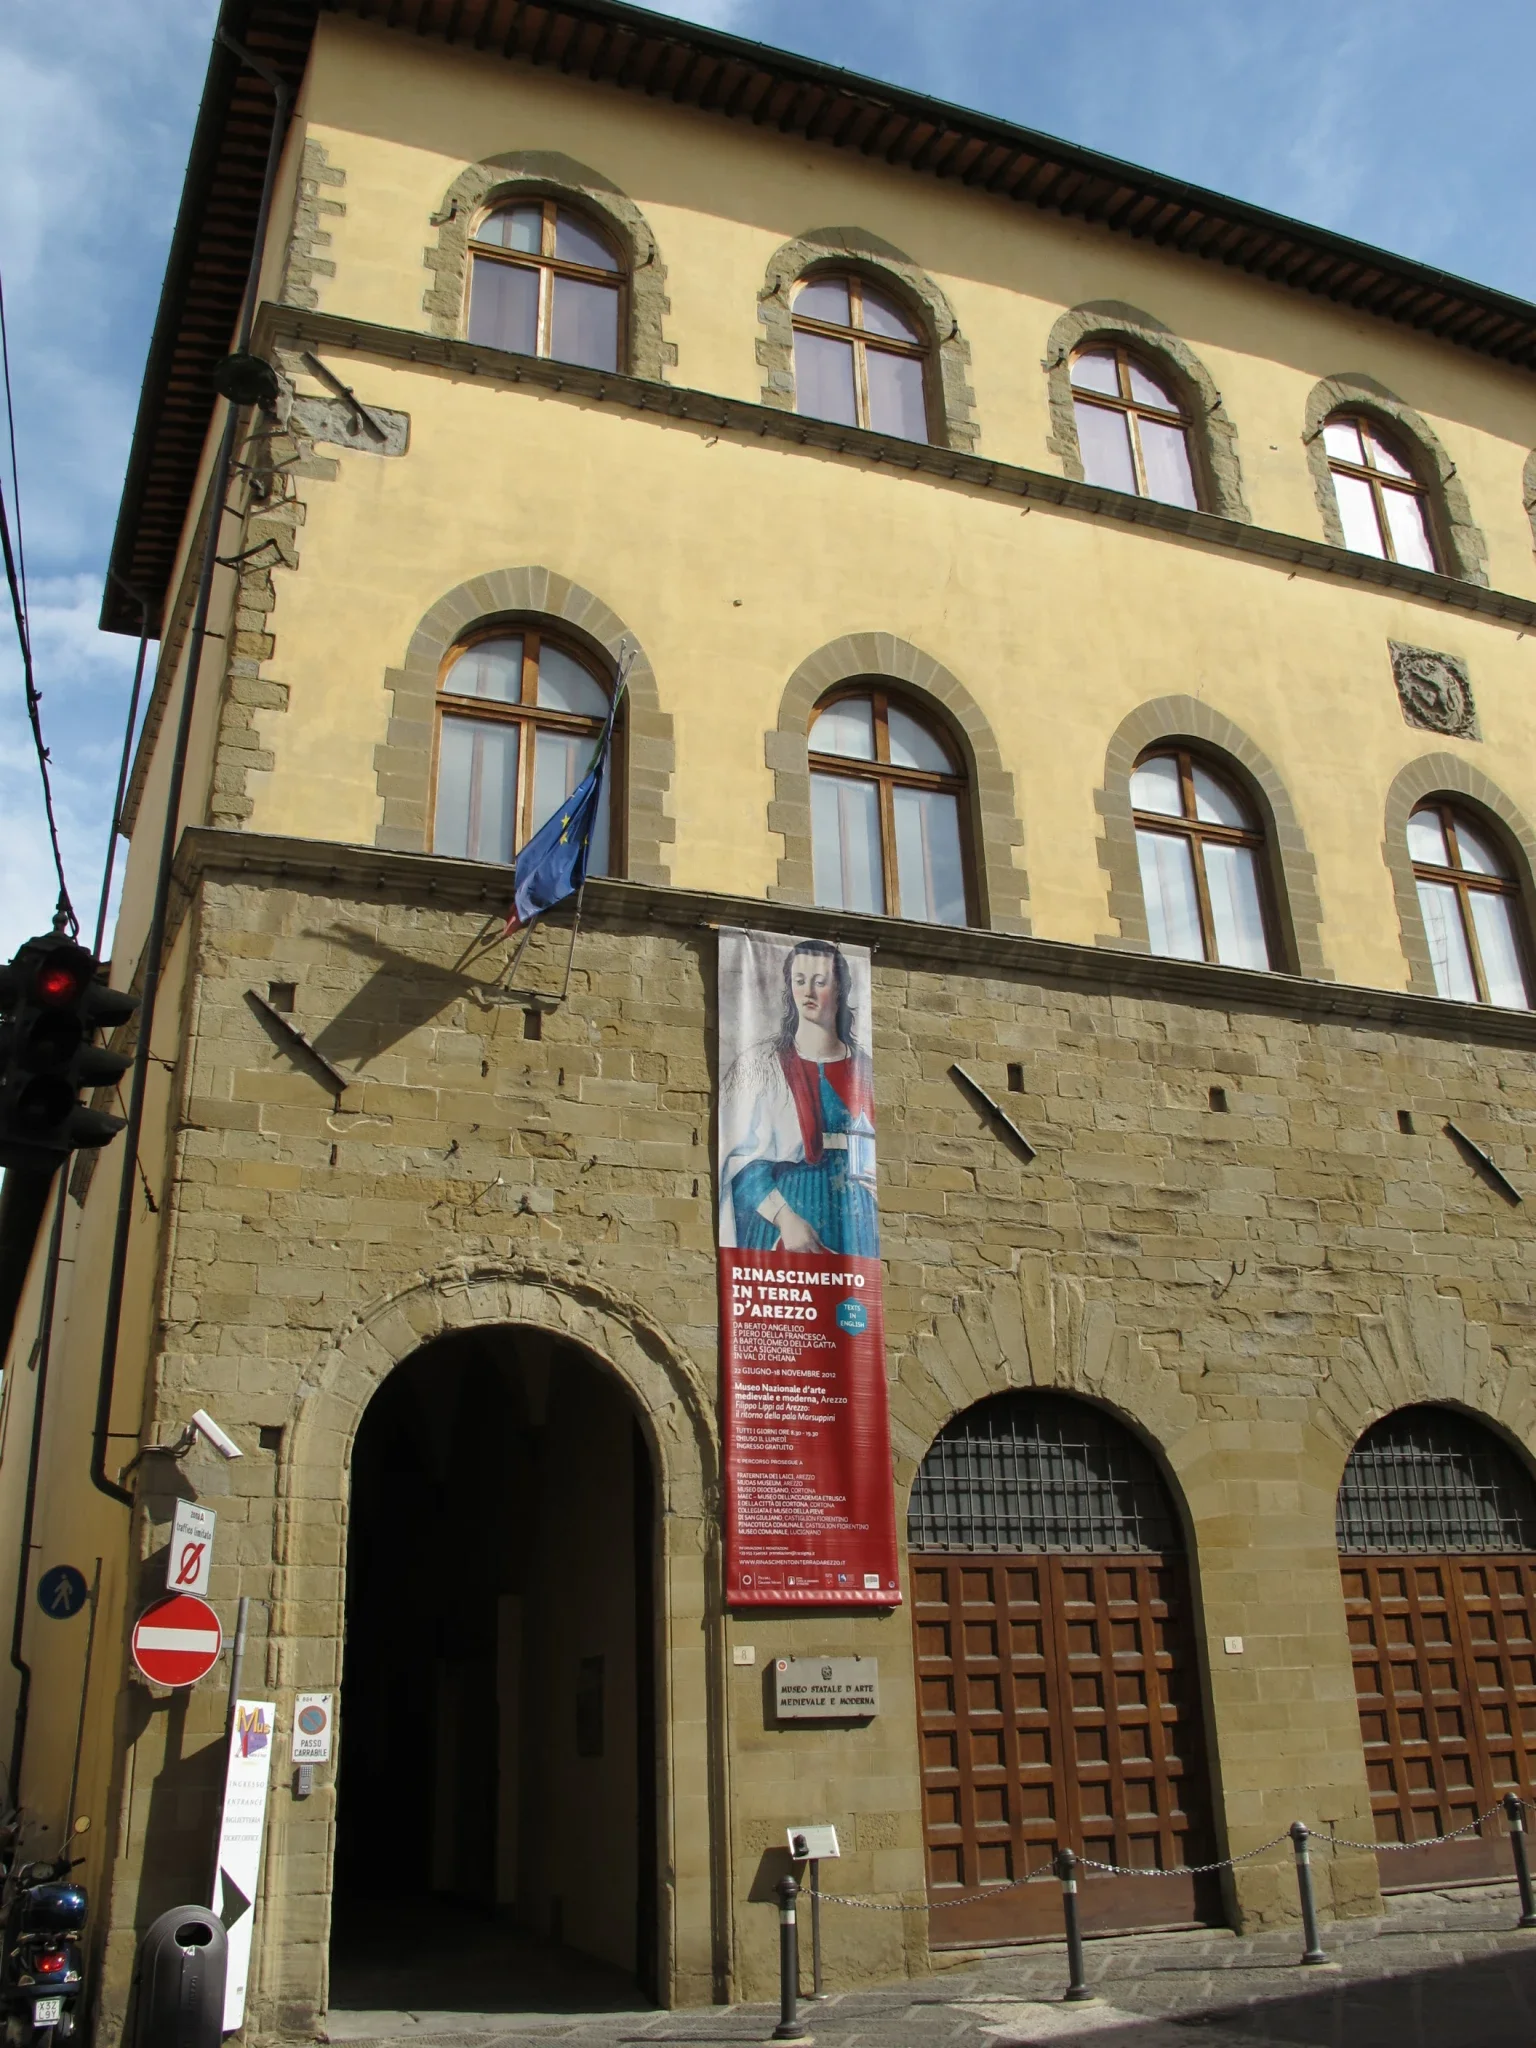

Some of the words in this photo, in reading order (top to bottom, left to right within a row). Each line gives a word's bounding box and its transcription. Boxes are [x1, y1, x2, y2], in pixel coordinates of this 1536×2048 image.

[732, 1266, 865, 1288] RINASCIMENTO
[732, 1284, 752, 1298] IN
[758, 1286, 813, 1302] TERRA
[732, 1300, 818, 1320] D'AREZZO
[844, 1304, 860, 1312] TEXTS
[744, 1322, 766, 1330] BEATO
[768, 1324, 804, 1332] ANGELICO
[840, 1320, 864, 1328] ENGLISH
[762, 1331, 784, 1339] DELLA
[785, 1332, 826, 1341] FRANCESCA
[740, 1338, 788, 1347] BARTOLOMEO
[790, 1340, 812, 1348] DELLA
[760, 1346, 802, 1355] SIGNORELLI
[742, 1367, 780, 1375] GIUGNO-18
[782, 1369, 820, 1377] NOVEMBRE
[734, 1382, 760, 1391] Museo
[762, 1383, 801, 1393] Nazionale
[802, 1385, 826, 1394] d'arte
[735, 1392, 774, 1401] medievale
[782, 1394, 819, 1404] moderna,
[735, 1400, 756, 1410] Filippo
[758, 1402, 774, 1412] Lippi
[786, 1403, 810, 1412] Arezzo:
[740, 1411, 763, 1419] ritorno
[764, 1412, 780, 1420] della
[782, 1412, 796, 1421] pala
[798, 1413, 835, 1423] Marsuppini
[176, 1522, 193, 1535] traffico
[194, 1526, 211, 1540] limitato
